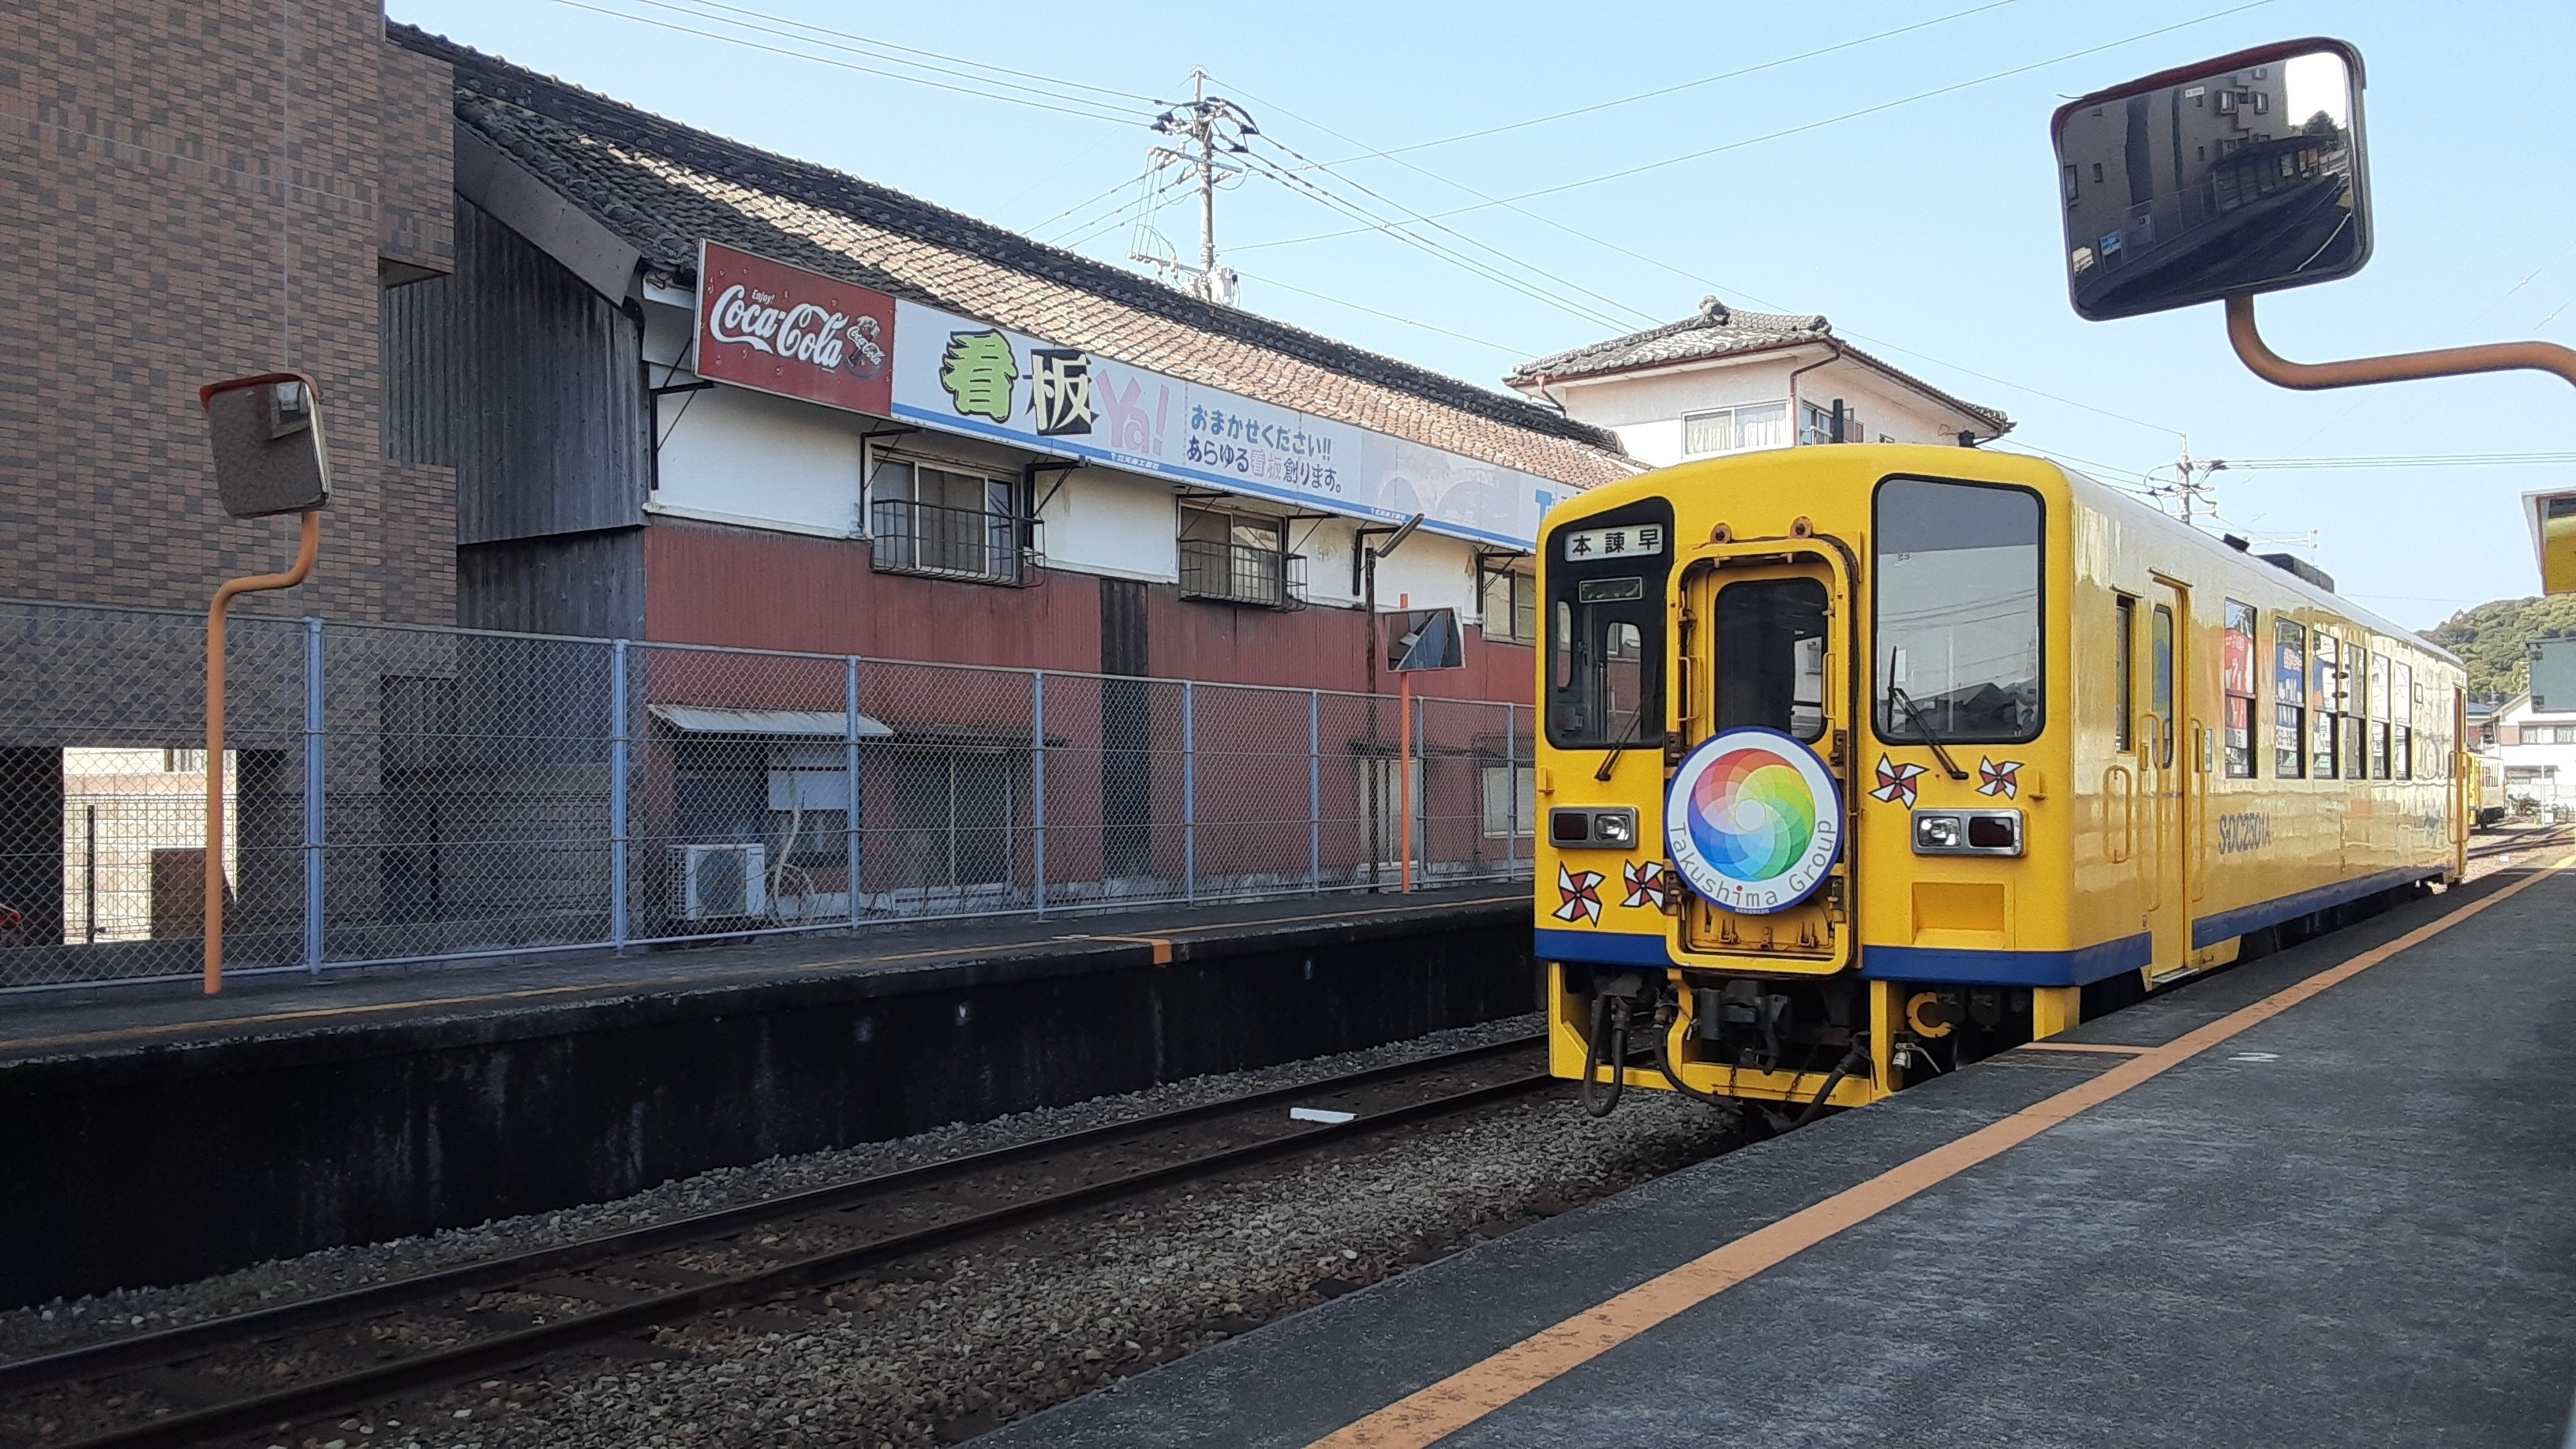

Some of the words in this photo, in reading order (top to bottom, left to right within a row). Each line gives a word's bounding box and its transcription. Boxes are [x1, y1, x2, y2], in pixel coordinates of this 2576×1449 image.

[710, 284, 850, 368] Coca-Cola
[751, 289, 776, 305] Enjoy!
[1186, 435, 1342, 493] あらゆる看板創ります。
[1572, 528, 1660, 556] 本諫早
[1670, 822, 1779, 907] Takushima
[1789, 820, 1837, 893] Group
